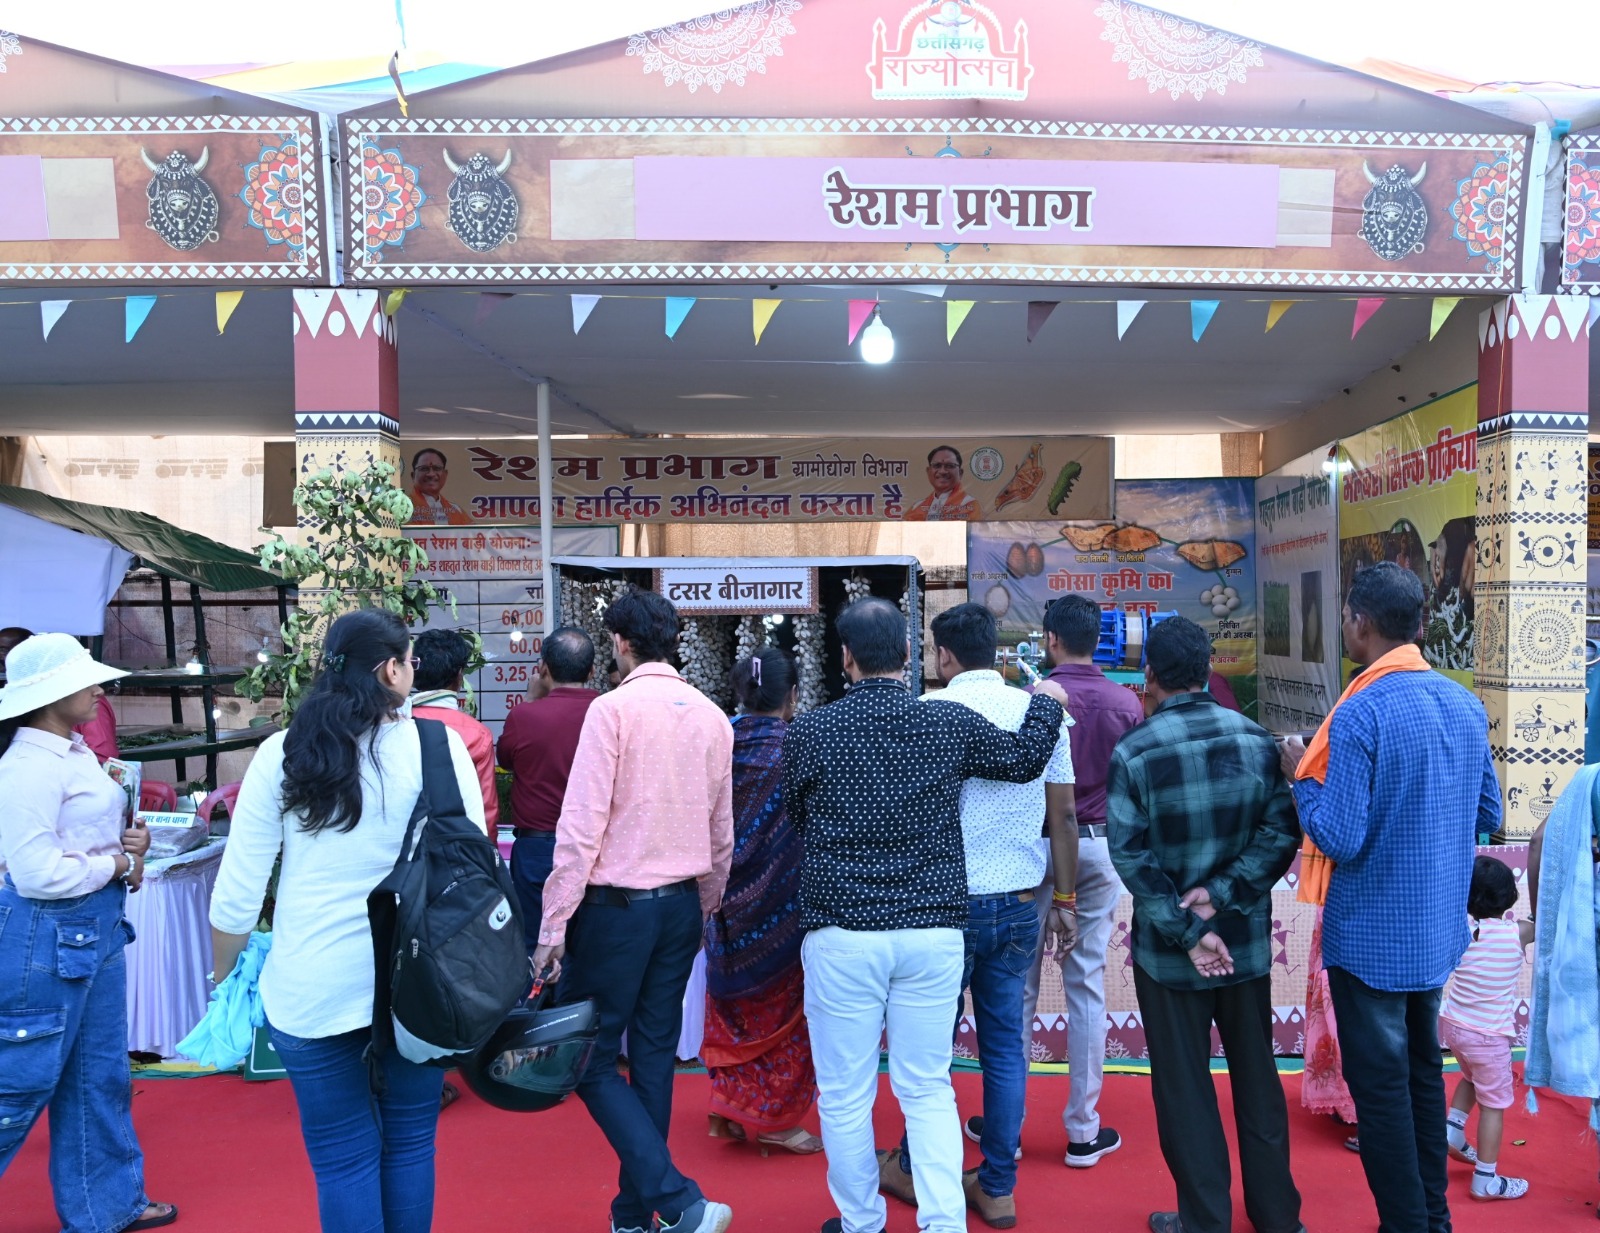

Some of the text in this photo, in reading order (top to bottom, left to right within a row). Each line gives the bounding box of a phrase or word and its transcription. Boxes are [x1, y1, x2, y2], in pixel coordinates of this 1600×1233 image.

[916, 34, 986, 53] छत्तीसगढ़
[884, 52, 1016, 88] राज्योत्सव
[826, 170, 1093, 230] रेशम प्रभाग
[619, 454, 781, 482] प्रभाग
[792, 453, 857, 478] ग्रामोद्योग
[862, 453, 909, 478] विभाग
[574, 486, 662, 522] हार्दिक
[670, 485, 792, 520] अभिनंदन
[800, 493, 876, 519] करता
[882, 484, 902, 519] है
[431, 533, 458, 551] रेशम
[461, 534, 487, 553] बाड़ी
[463, 556, 479, 573] रेशम
[481, 556, 495, 573] बाड़ी
[497, 555, 521, 572] विकास
[522, 555, 533, 574] हेतु
[667, 574, 804, 601] टसर बीजागार
[1047, 568, 1173, 598] कोसा कृमि का
